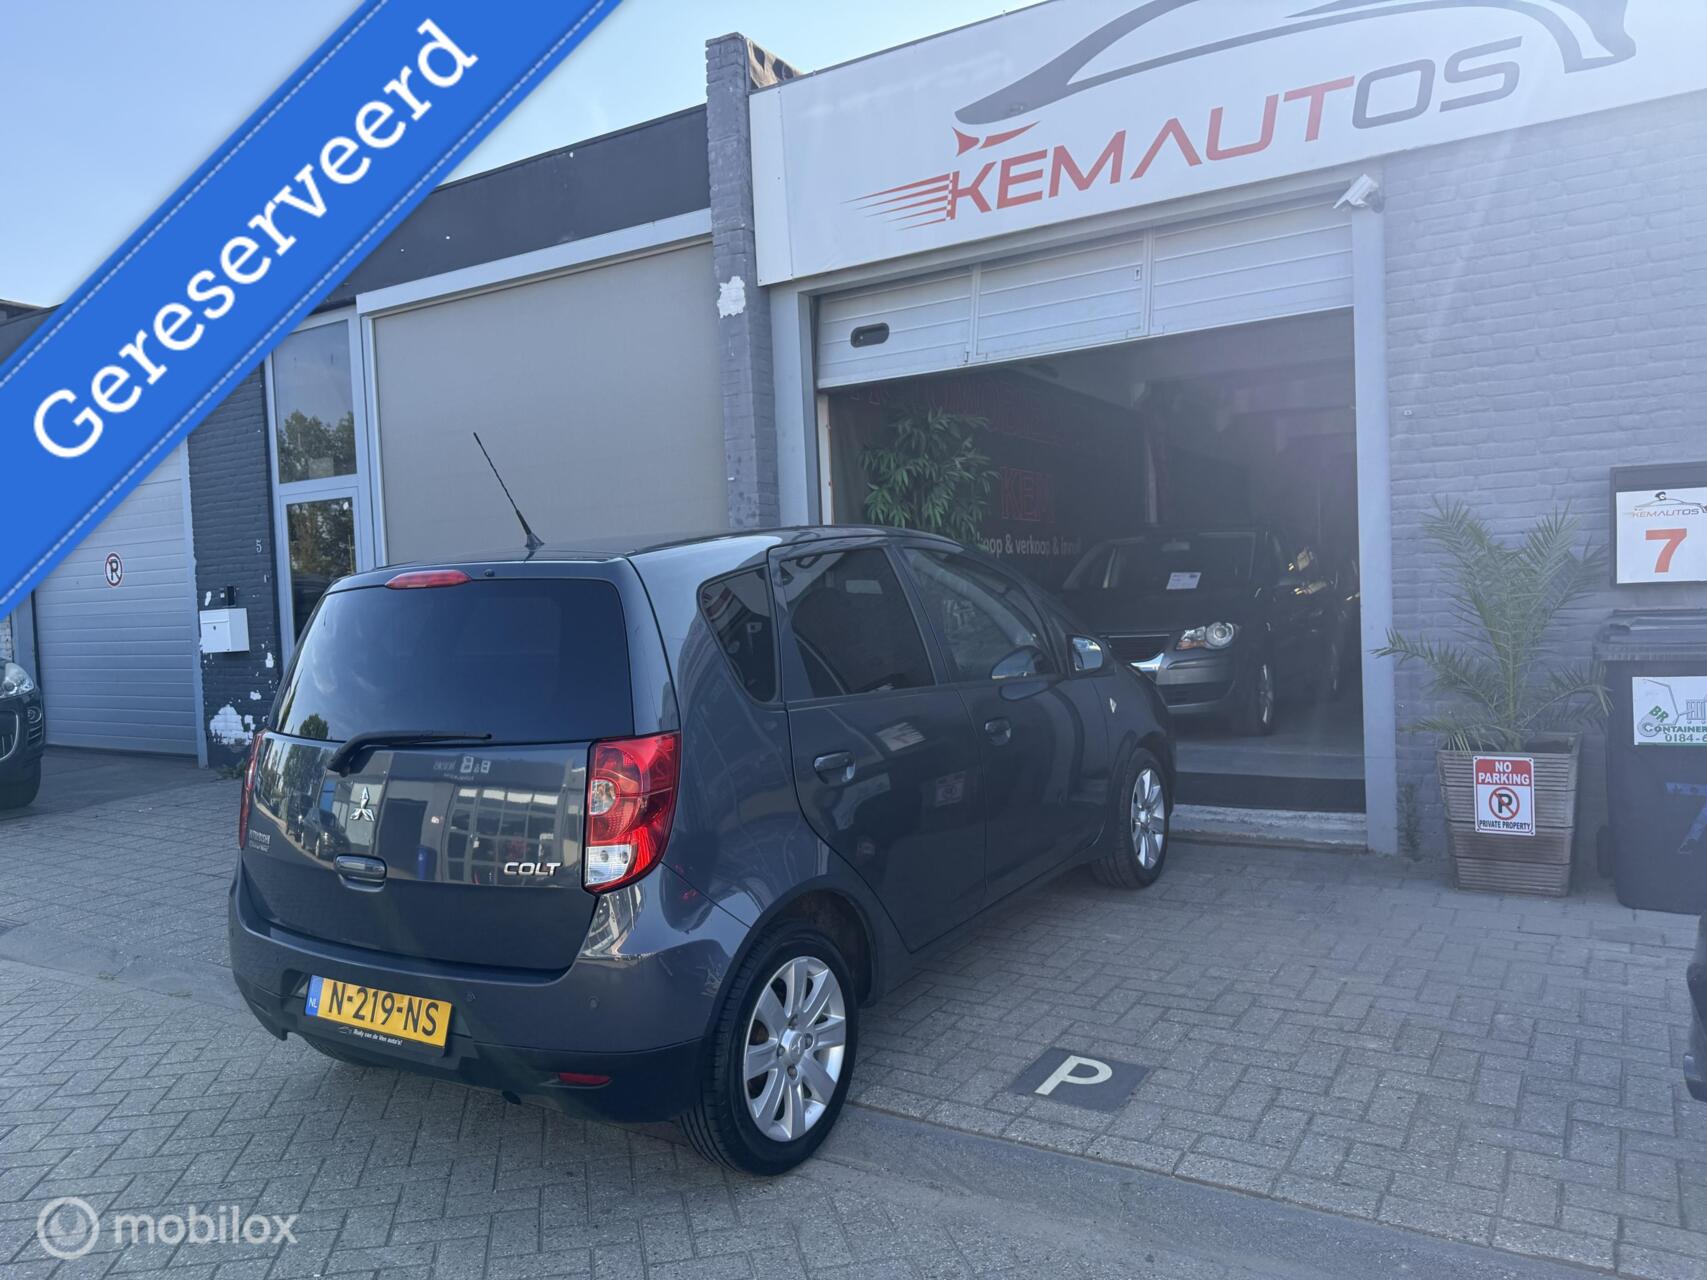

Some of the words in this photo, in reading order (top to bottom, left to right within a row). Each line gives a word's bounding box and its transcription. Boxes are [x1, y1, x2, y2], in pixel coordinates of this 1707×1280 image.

[946, 35, 1522, 220] KEMAUTOS
[1632, 508, 1700, 518] KEMAUTOS
[1645, 528, 1687, 573] 7
[1648, 705, 1669, 723] BR
[1495, 761, 1512, 773] NO
[1478, 772, 1530, 785] PARKING
[1479, 819, 1501, 829] PRIVATE
[1502, 820, 1531, 831] PROPERTY
[503, 861, 561, 876] COLT
[308, 997, 318, 1008] NL
[328, 981, 440, 1037] N-219-NS
[1034, 1055, 1113, 1096] P
